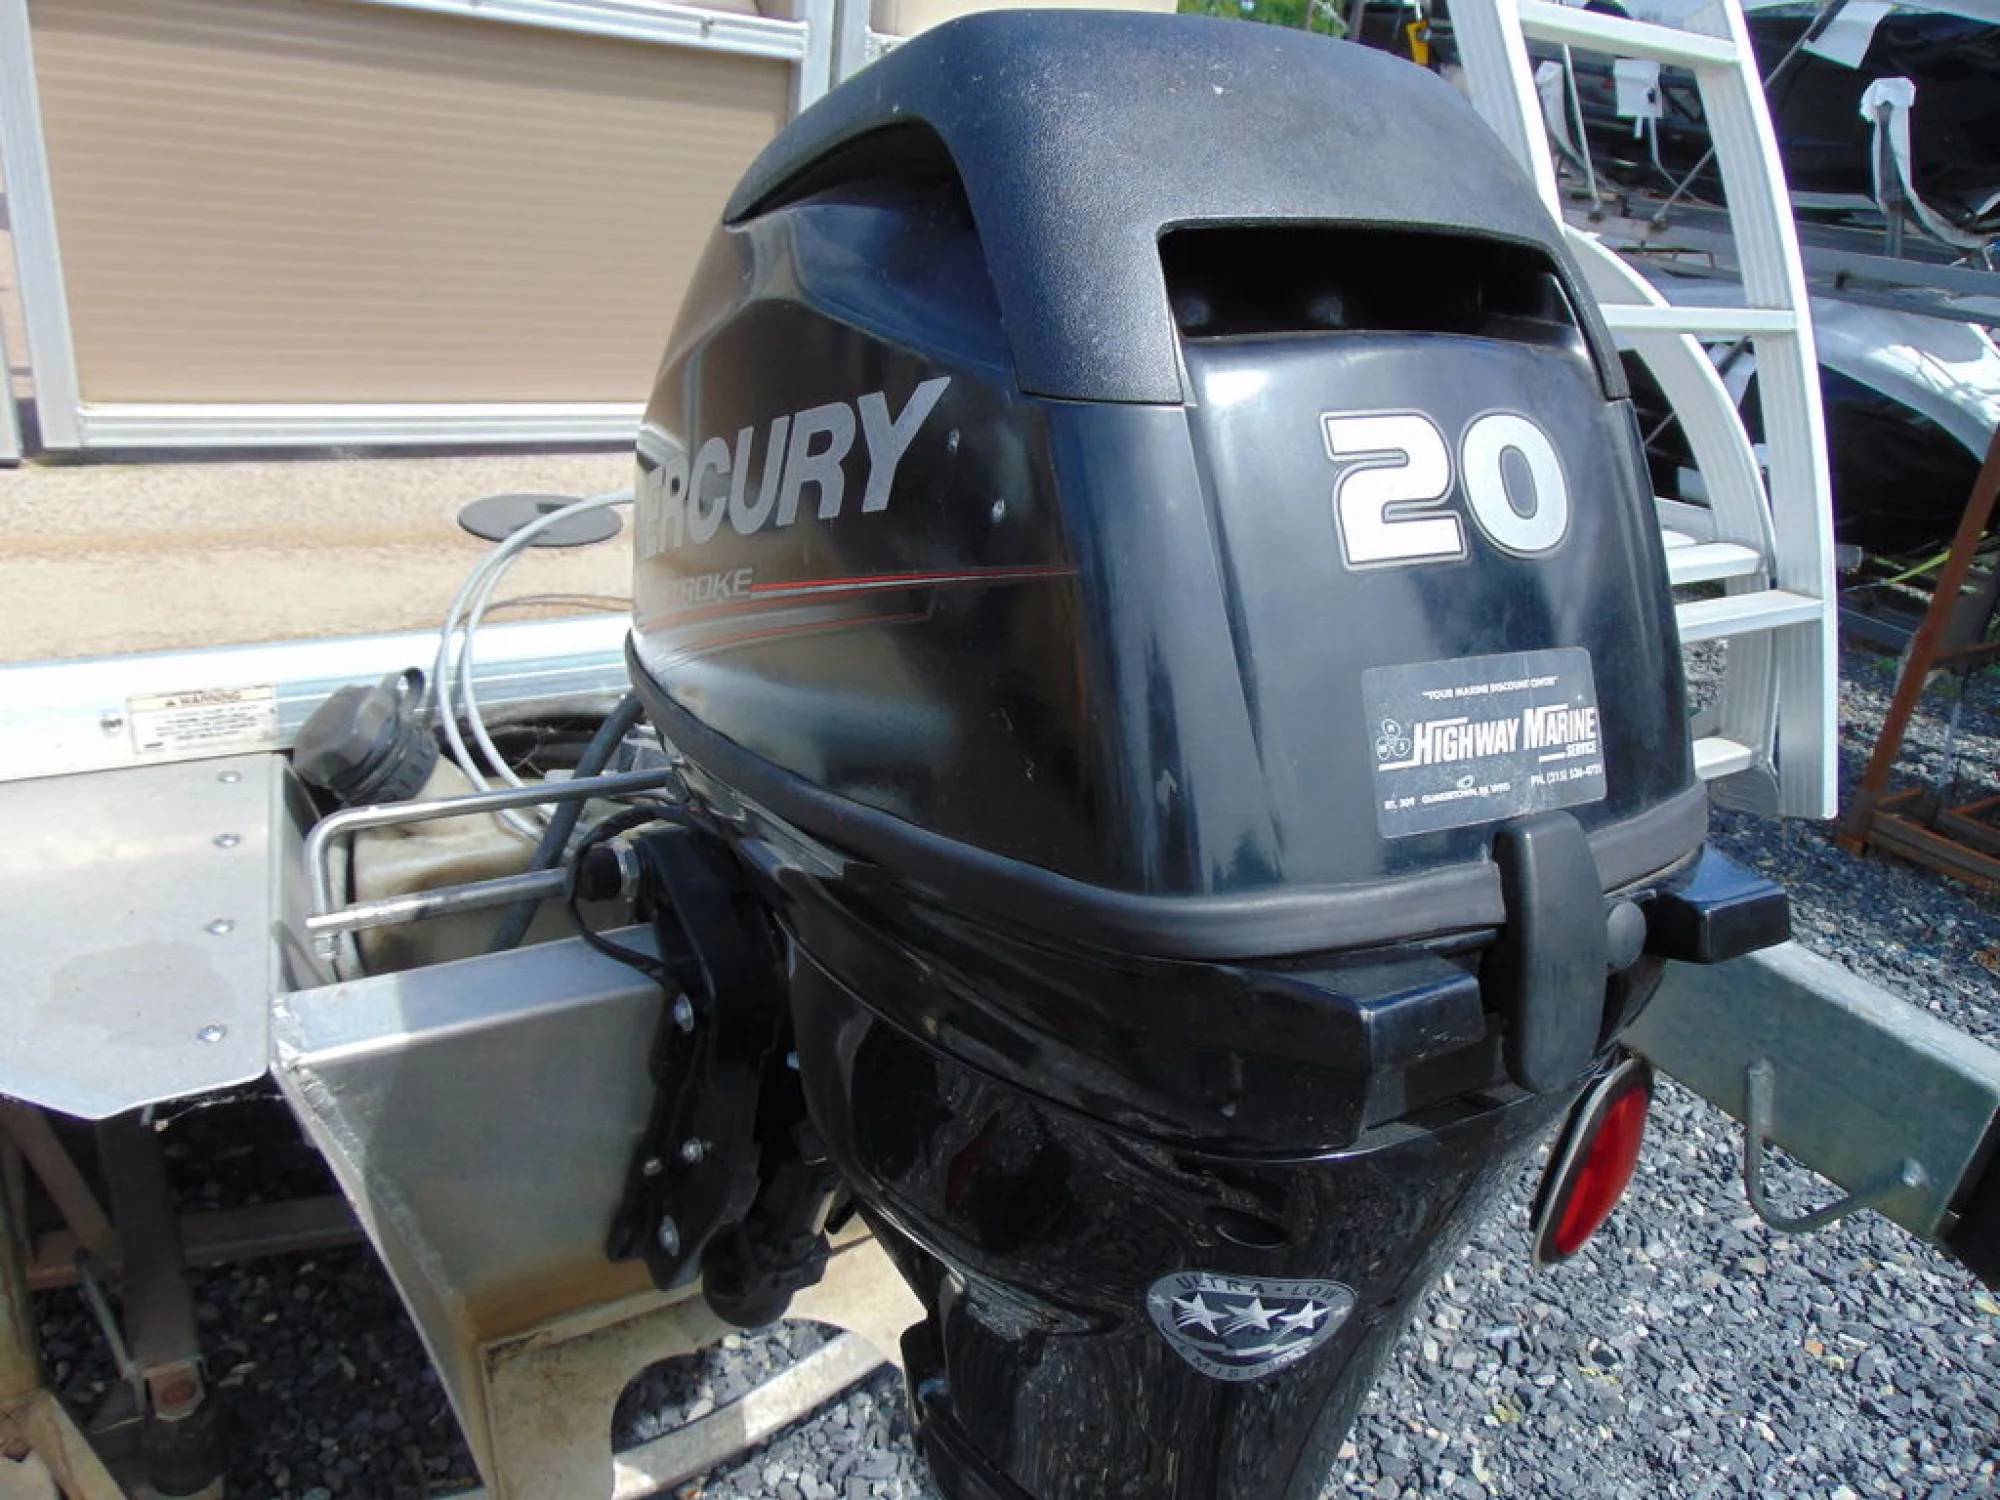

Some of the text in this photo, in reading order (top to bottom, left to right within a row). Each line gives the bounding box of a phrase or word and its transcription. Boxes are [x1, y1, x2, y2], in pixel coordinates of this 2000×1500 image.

[636, 376, 951, 560] ERCURY
[1319, 407, 1572, 571] 20
[1413, 716, 1520, 767] HIGHWAY
[1523, 703, 1596, 750] MARINE
[1567, 740, 1597, 758] SERVICE
